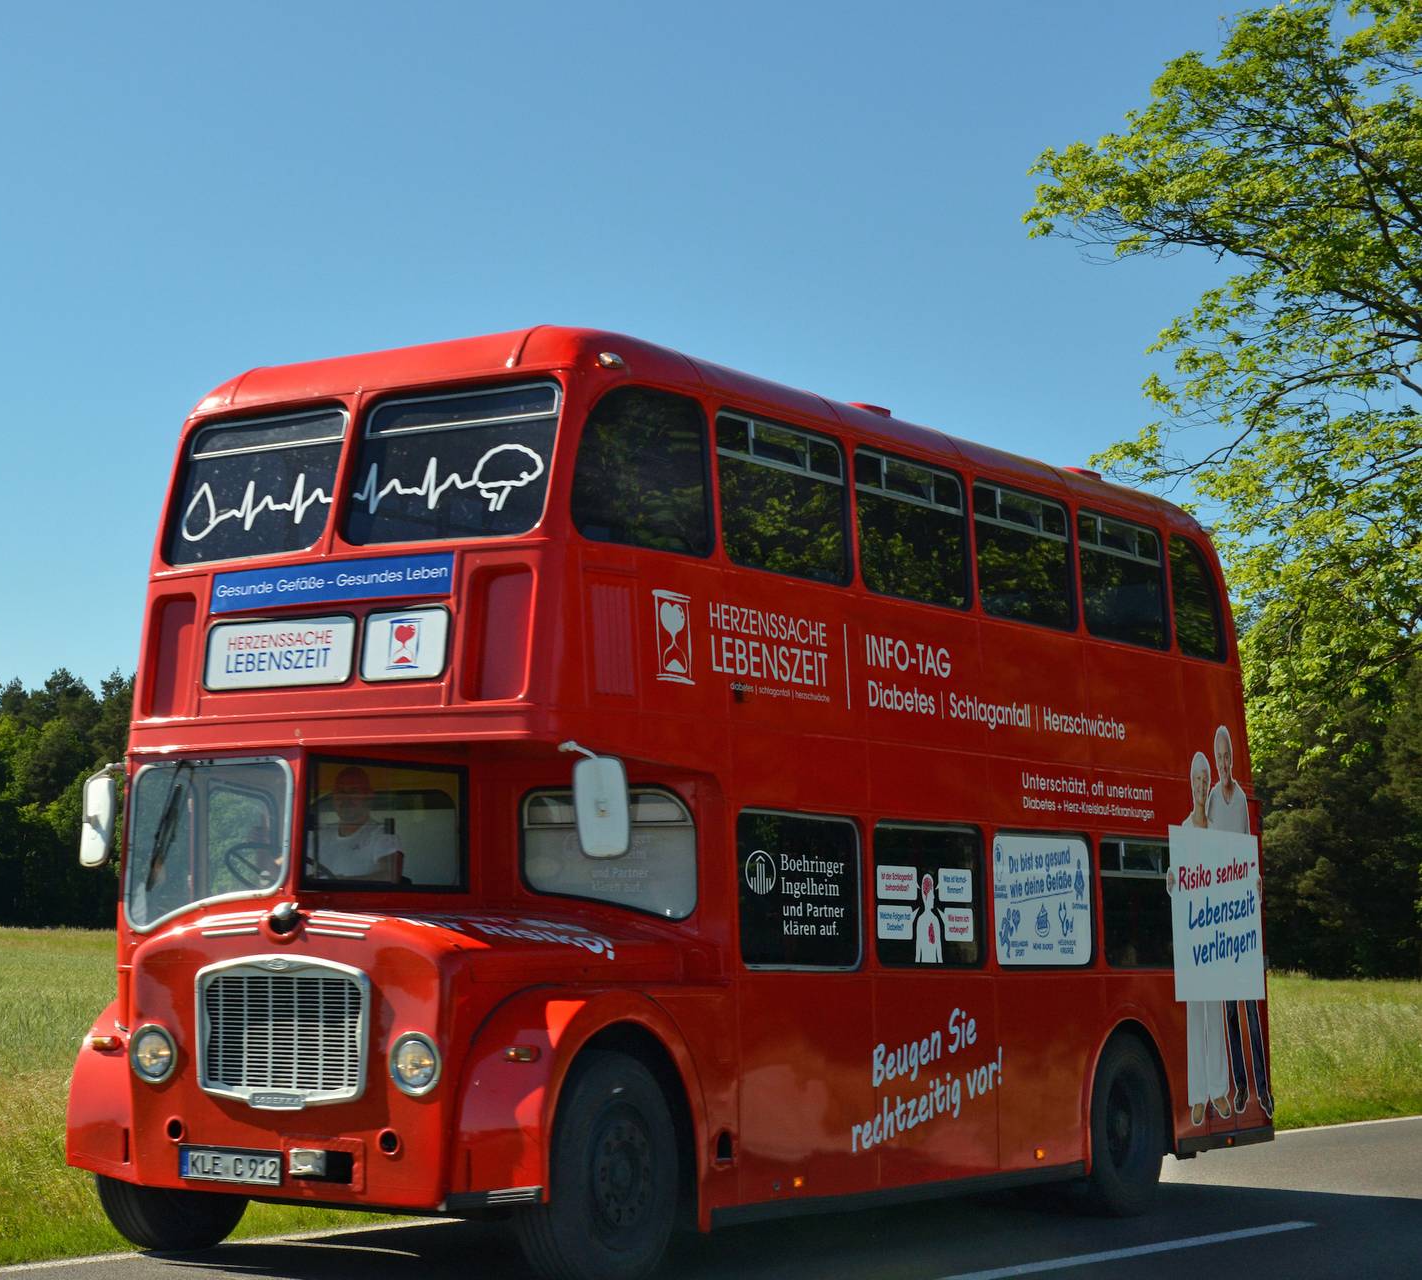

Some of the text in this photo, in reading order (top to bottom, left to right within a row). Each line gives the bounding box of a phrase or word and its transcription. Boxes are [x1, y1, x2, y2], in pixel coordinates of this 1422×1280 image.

[216, 582, 272, 598] Gesunde
[276, 574, 324, 593] Gefäße
[336, 568, 402, 587] Gesundes
[406, 566, 448, 581] Leben
[709, 600, 827, 647] HERZENSSACHE
[228, 629, 332, 651] HERZENSSACHE
[226, 648, 331, 674] LEBENSZEIT
[710, 634, 828, 687] LEBENSZEIT
[866, 633, 951, 679] INFO-TAG
[868, 680, 936, 716] Diabetes
[949, 692, 1031, 731] Schlaganfall
[1043, 706, 1126, 741] Herzschwäche
[1022, 772, 1154, 802] Unterschätzt, oft unerkannt
[1022, 796, 1056, 812] Diabetes
[780, 853, 844, 877] Boehringer
[1008, 846, 1070, 874] Du bist so gesund
[1178, 864, 1212, 892] Risiko
[1216, 858, 1248, 884] senken
[781, 876, 840, 899] Ingelheim
[1010, 870, 1072, 898] wie deine Gefäße
[782, 902, 844, 919] und Partner
[1188, 890, 1256, 930] Lebenszeit
[467, 922, 615, 961] Risiko!
[783, 920, 840, 936] klären auf.
[1192, 928, 1258, 966] verlängern
[872, 1008, 977, 1088] Beugen Sie
[852, 1046, 1002, 1152] rechtzeitig vor!
[190, 1154, 278, 1180] KLE C 912
